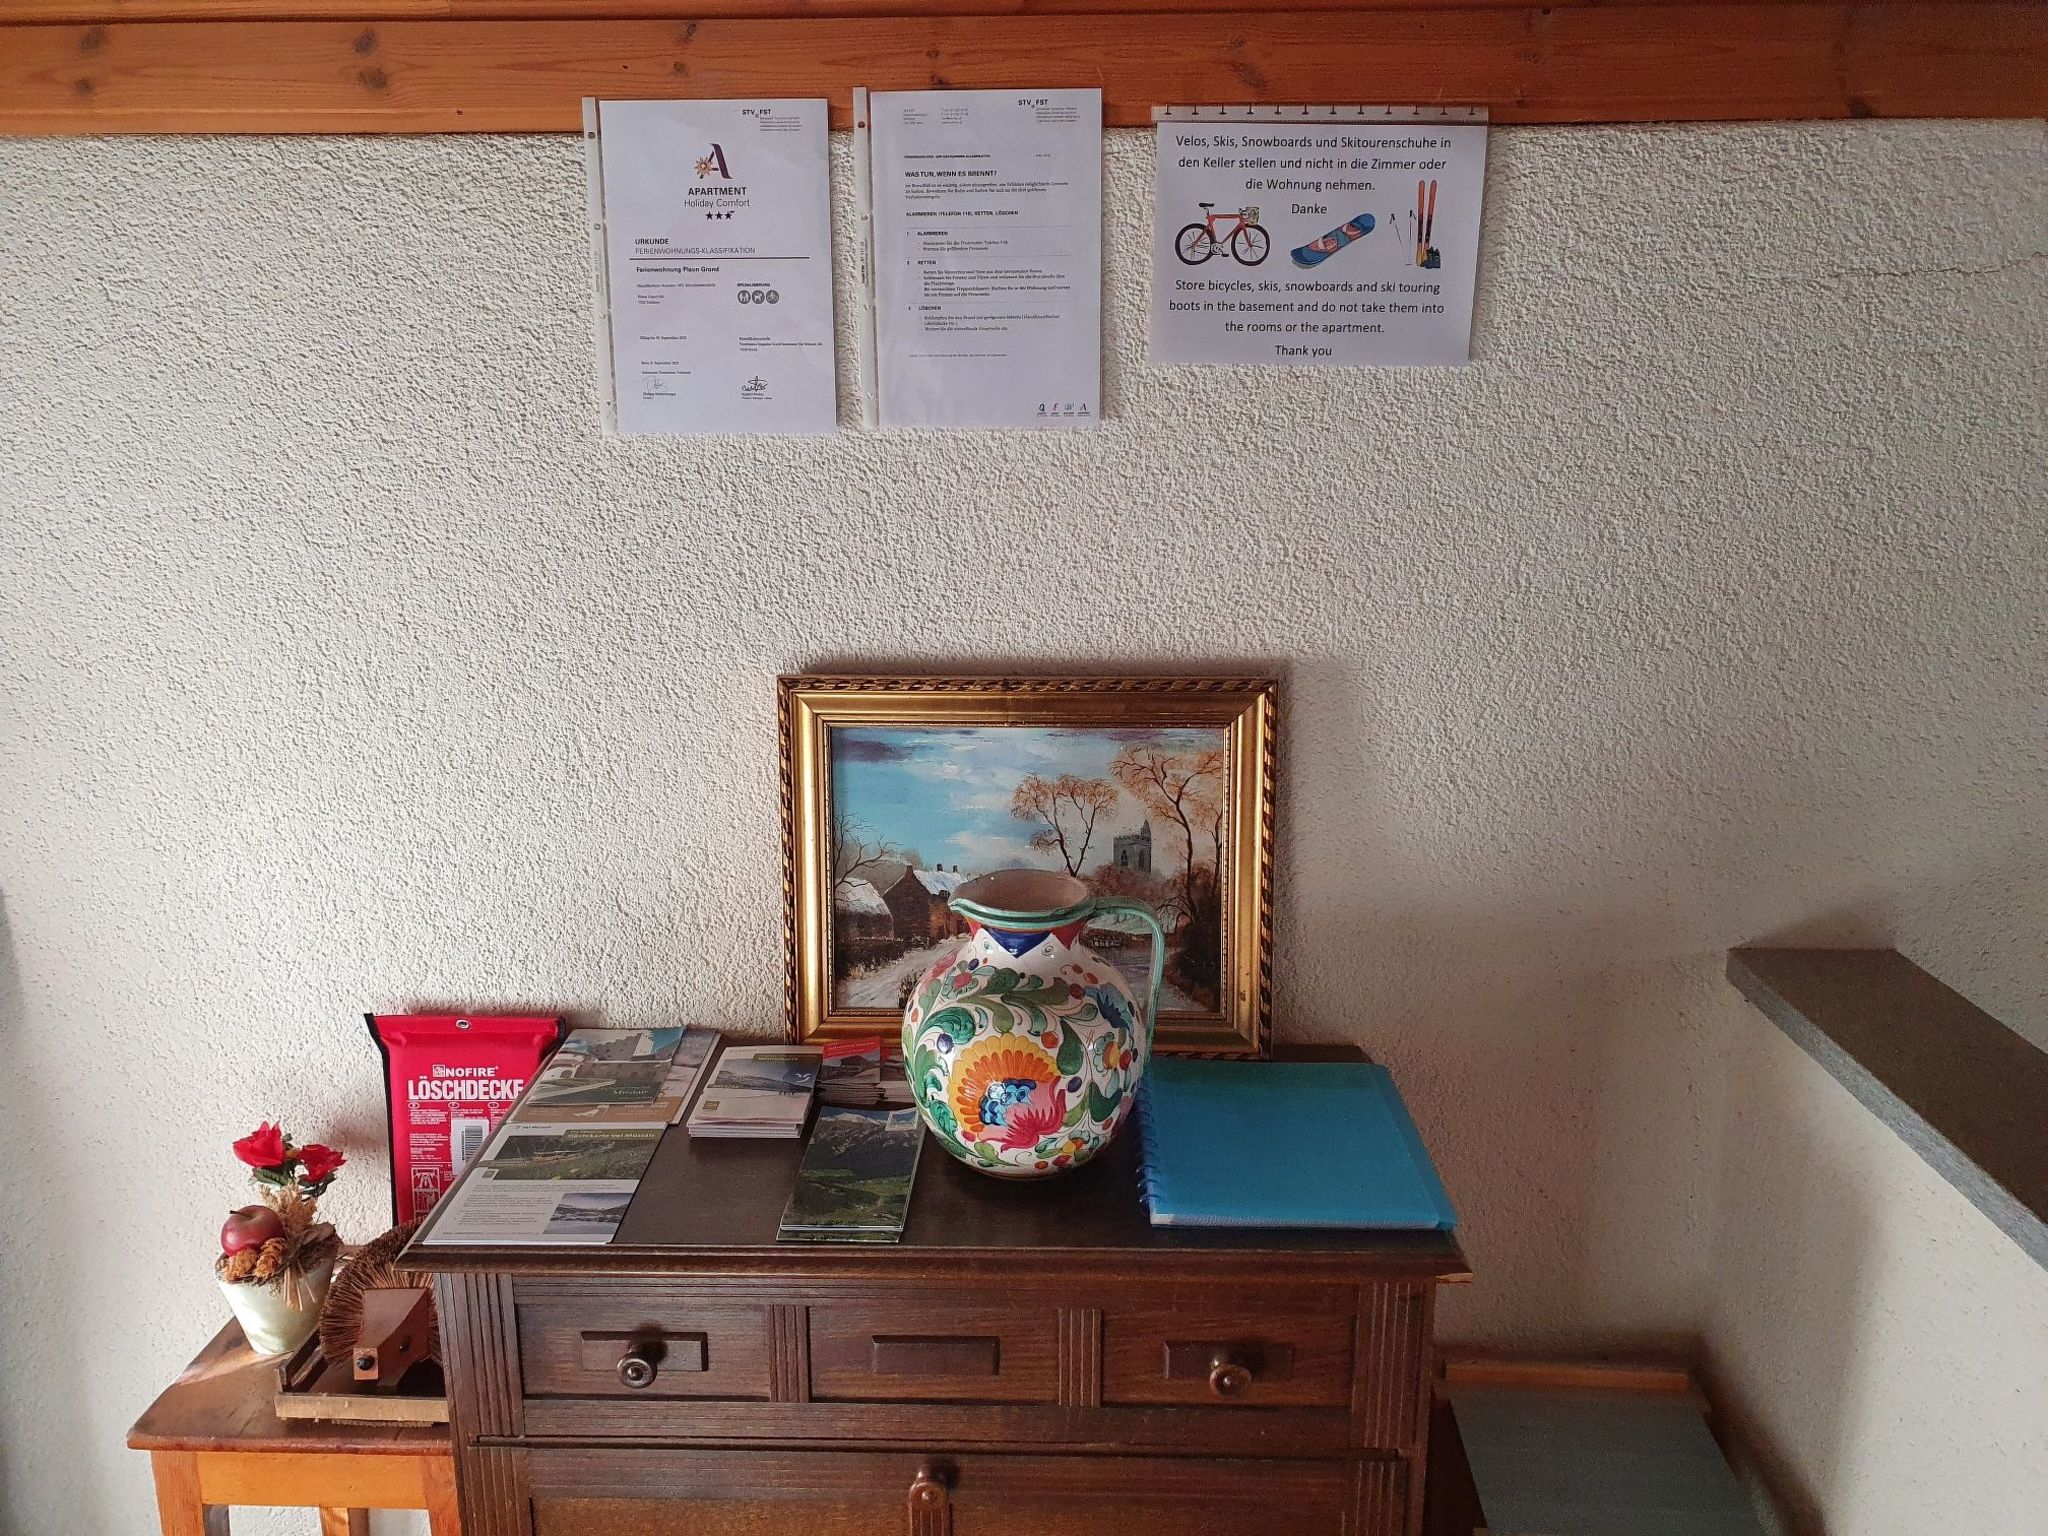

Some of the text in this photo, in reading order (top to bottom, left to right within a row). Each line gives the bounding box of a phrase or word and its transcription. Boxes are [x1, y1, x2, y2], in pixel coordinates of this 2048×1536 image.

[1176, 133, 1452, 151] Velos, Skis, Snowboards und Skitourenschuhe in
[1179, 155, 1446, 171] den Keller stellen und nicht in die Zimmer oder
[688, 187, 747, 196] APARTMENT
[1245, 176, 1375, 192] die Wohnung nehmen.
[685, 199, 750, 208] Holiday Comfort
[1290, 202, 1327, 216] Danke
[1176, 279, 1440, 296] Store bicycles, skis, snowboards and ski touring
[1170, 298, 1444, 314] boots in the basement and do not take them into
[1225, 320, 1384, 335] the rooms or the apartment.
[1275, 345, 1333, 358] Thank you
[445, 1067, 495, 1077] NOFIRE
